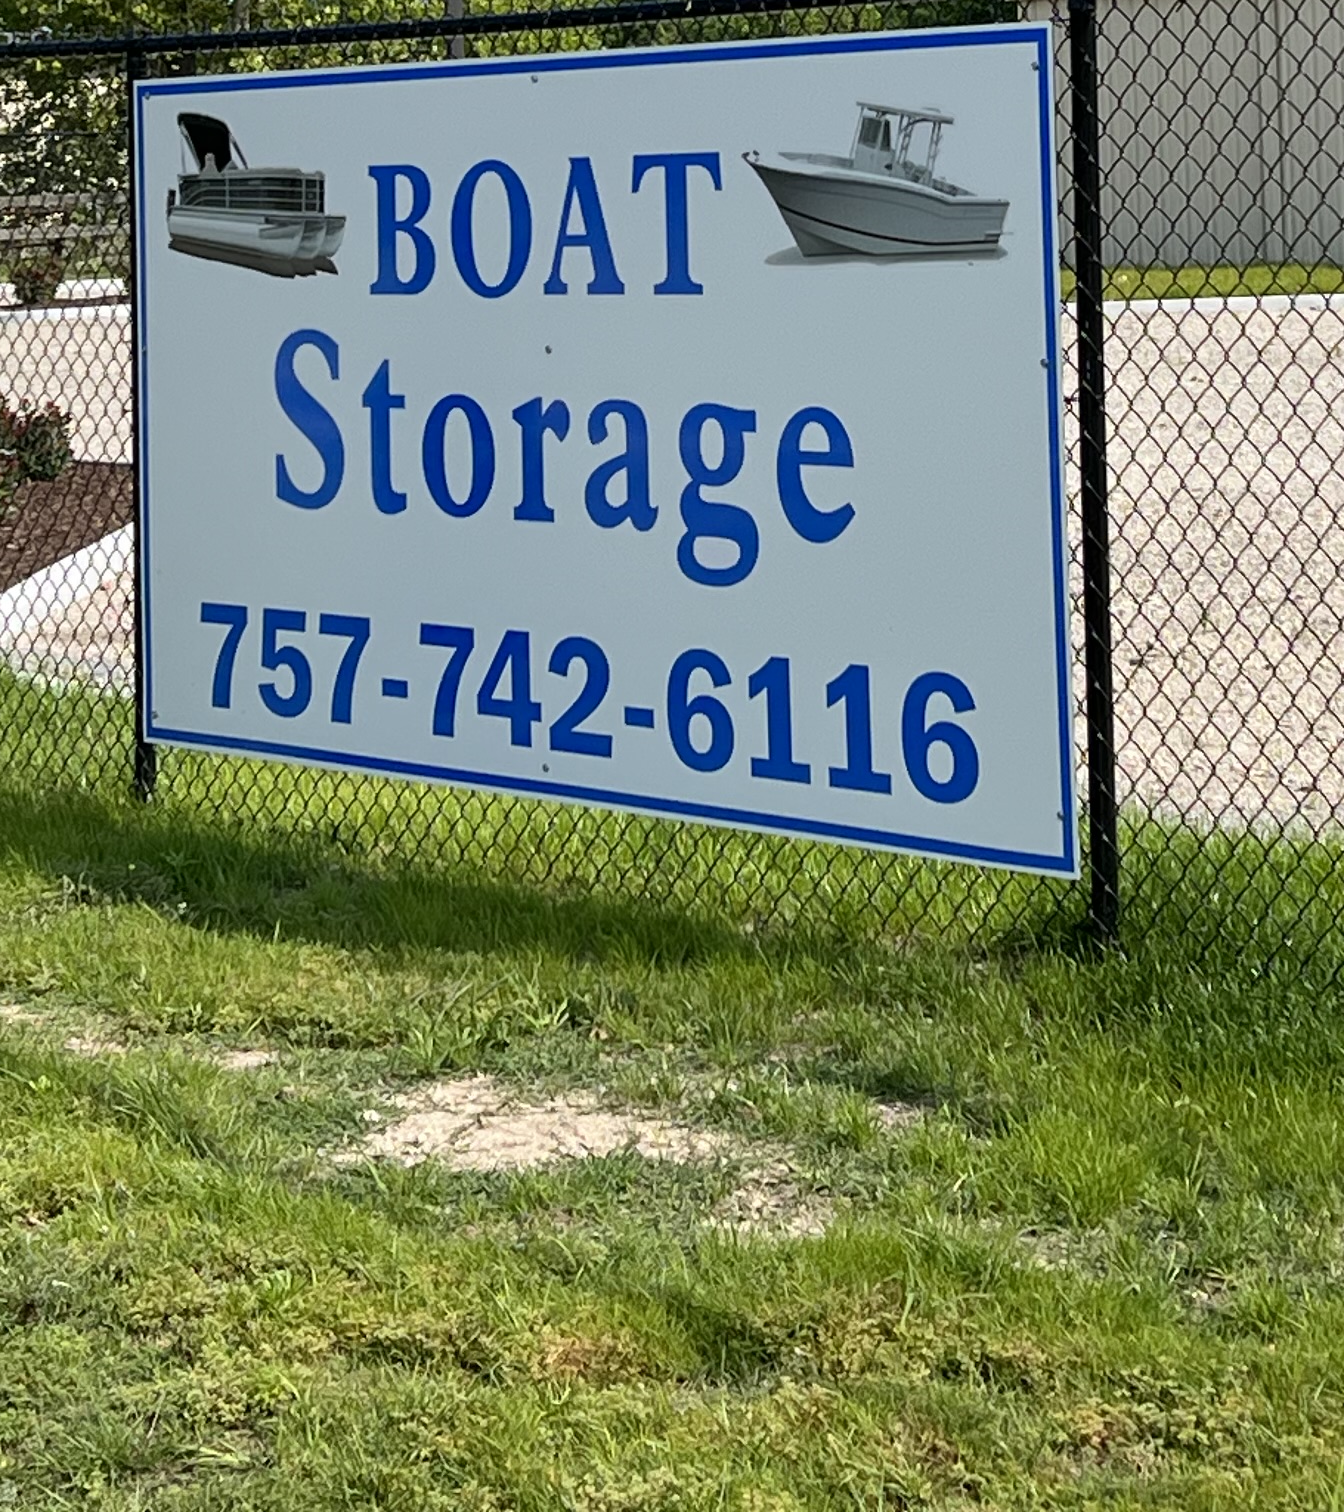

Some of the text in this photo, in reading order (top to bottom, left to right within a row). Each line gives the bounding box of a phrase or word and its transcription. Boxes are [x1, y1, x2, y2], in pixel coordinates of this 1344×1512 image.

[367, 150, 724, 300] BOAT
[273, 328, 858, 588] Storage
[199, 601, 980, 805] 757-742-6116
